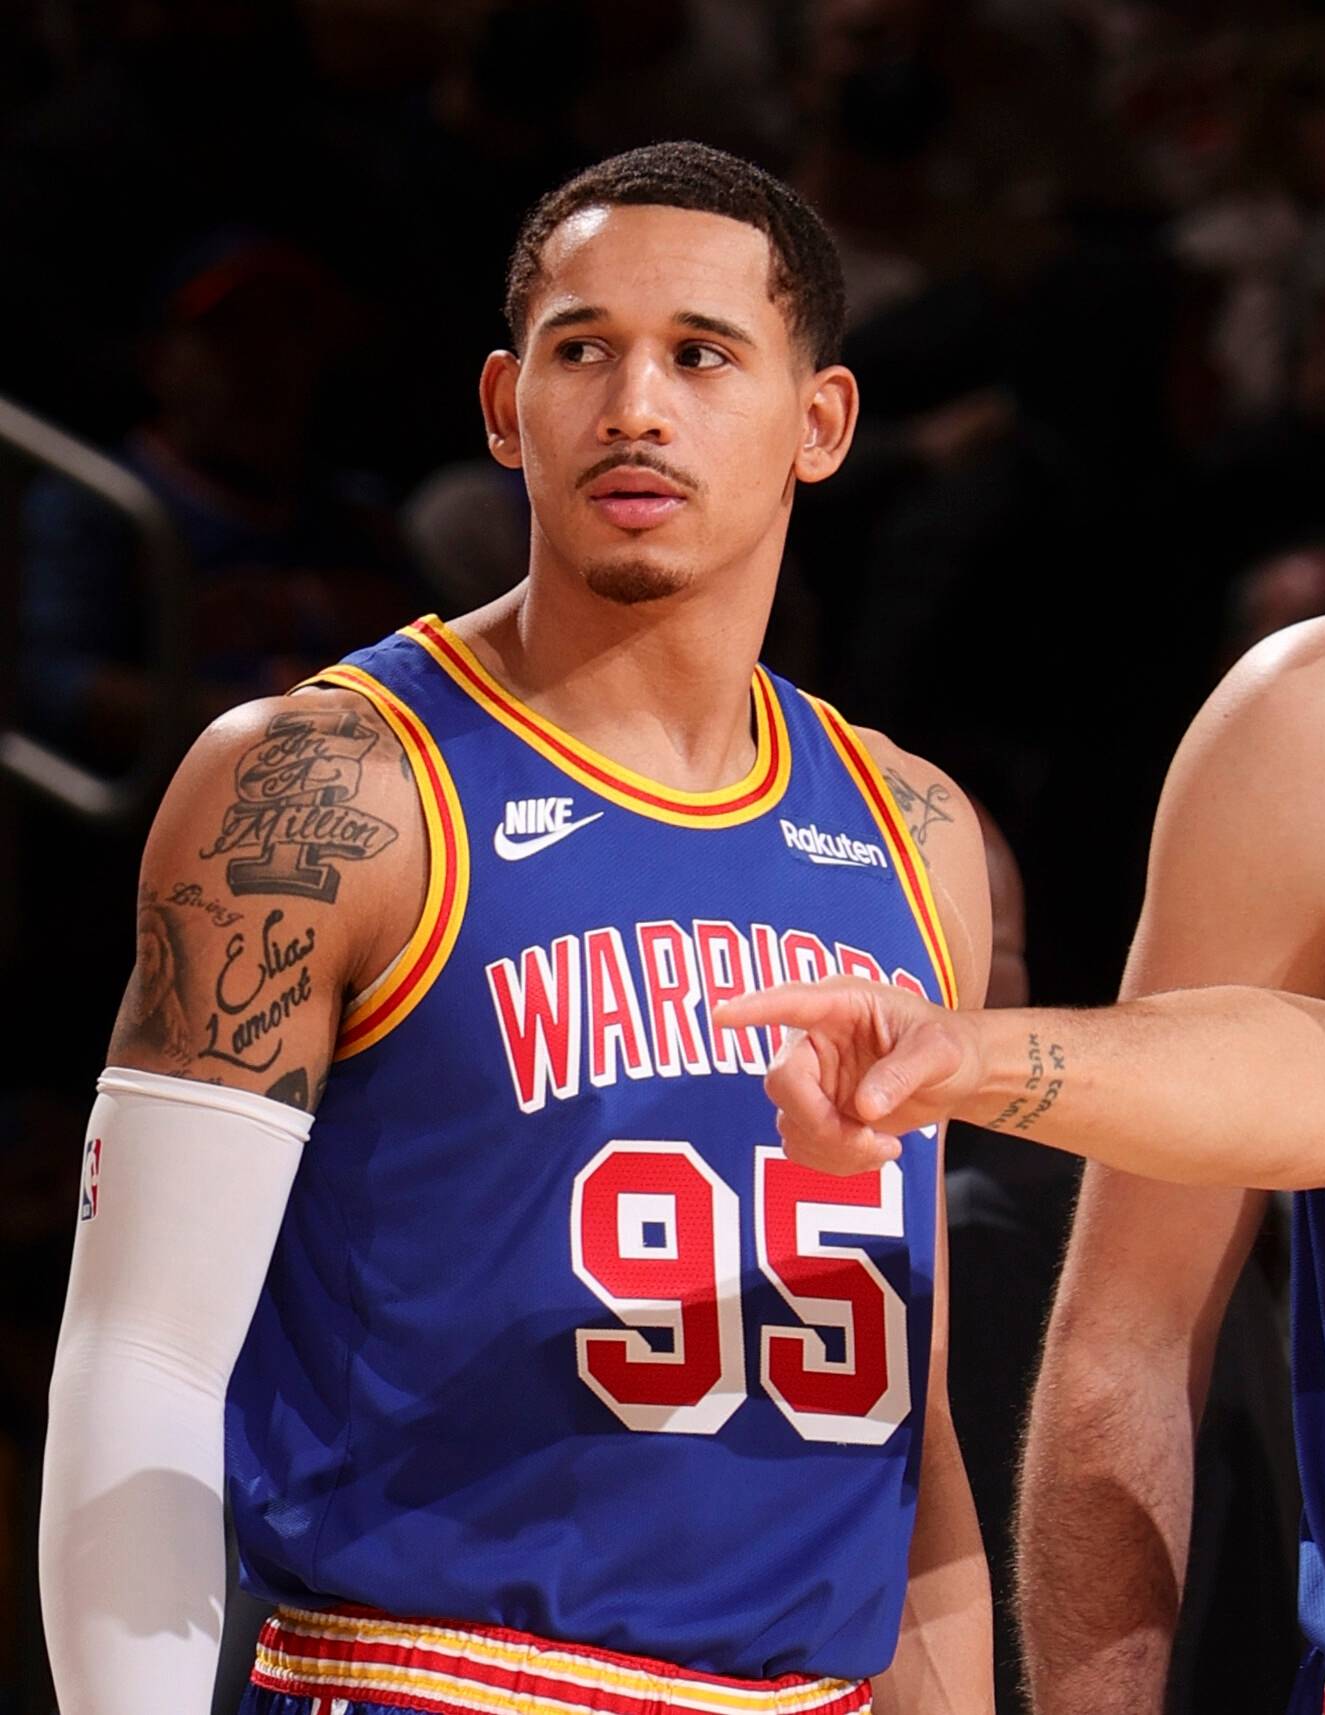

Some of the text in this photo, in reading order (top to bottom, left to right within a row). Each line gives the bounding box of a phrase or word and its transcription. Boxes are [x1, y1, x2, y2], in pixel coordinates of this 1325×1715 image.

[199, 803, 380, 859] Million
[505, 797, 574, 836] NIKE
[779, 818, 888, 869] Rakuten
[485, 919, 936, 1130] WARRI
[570, 1140, 912, 1445] 95
